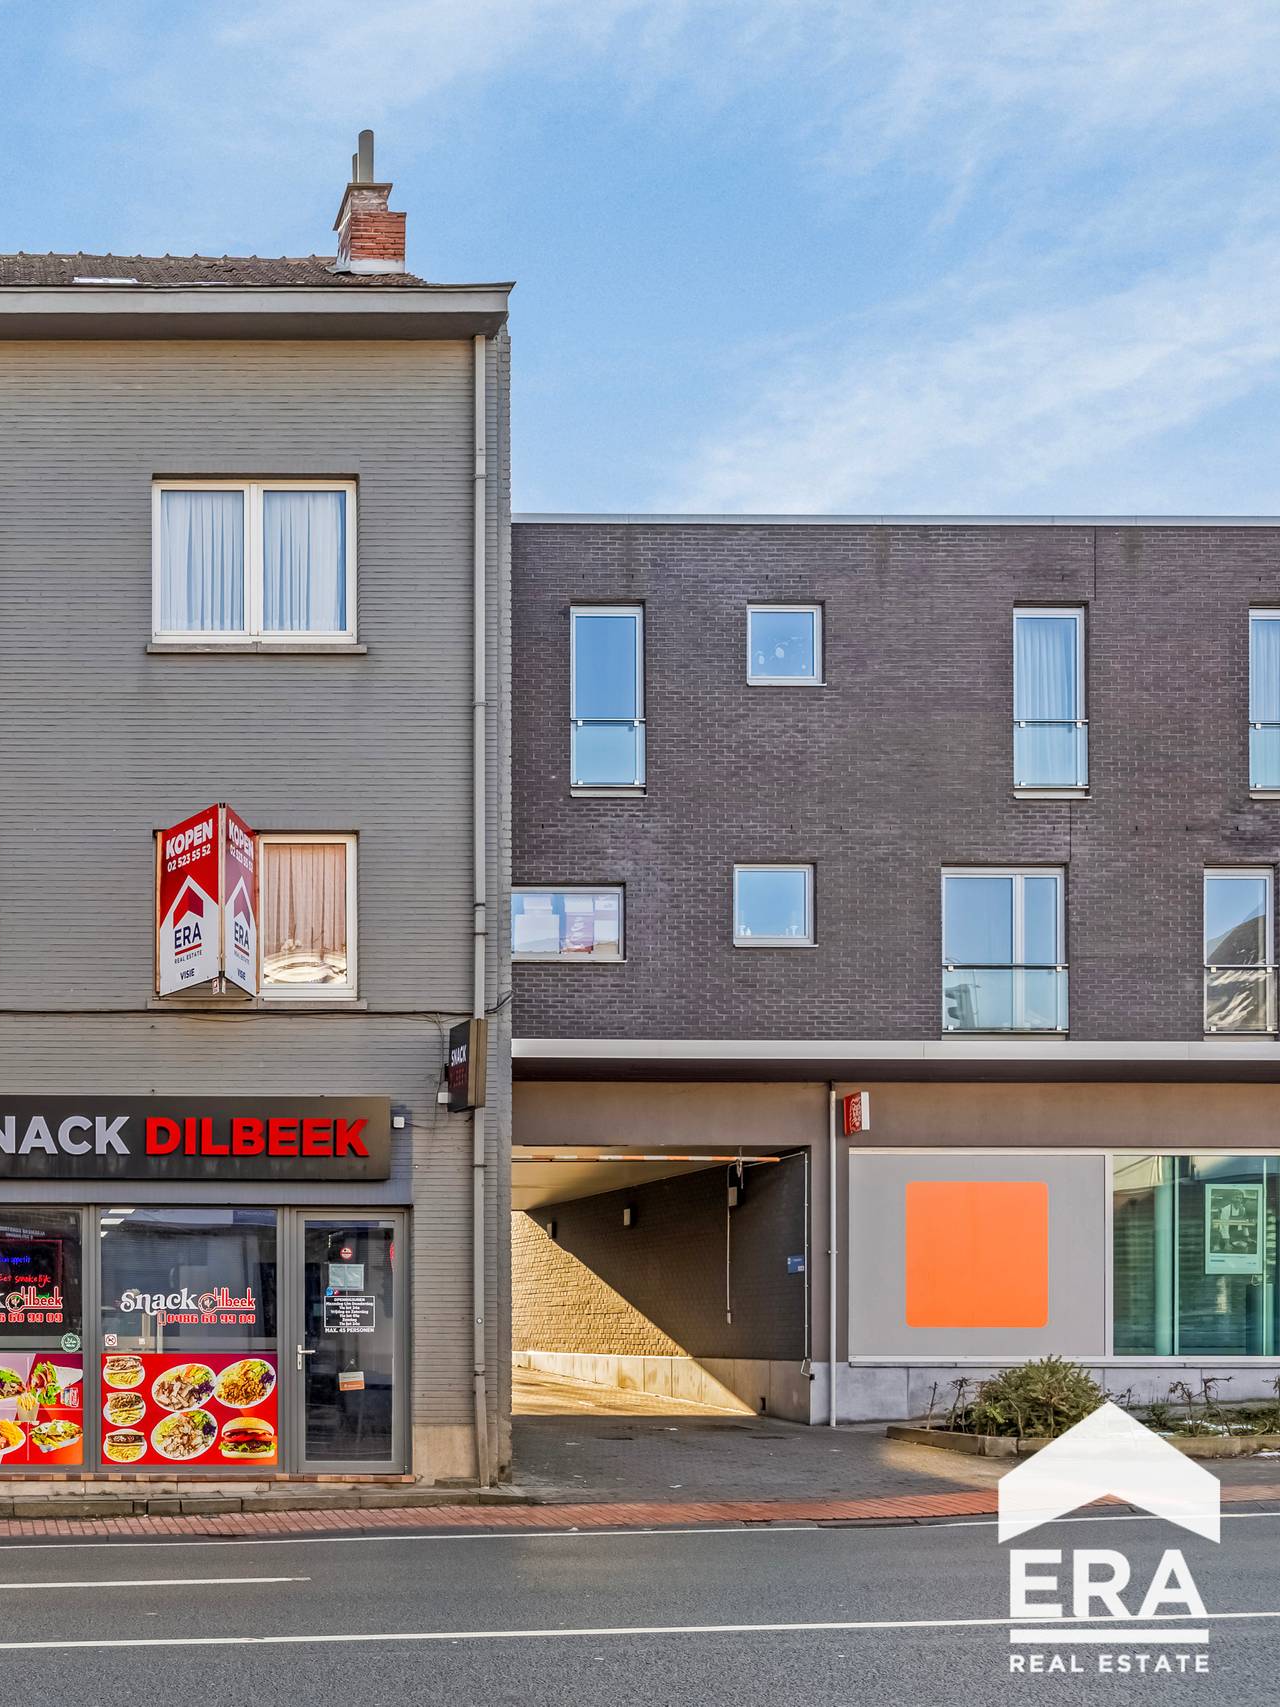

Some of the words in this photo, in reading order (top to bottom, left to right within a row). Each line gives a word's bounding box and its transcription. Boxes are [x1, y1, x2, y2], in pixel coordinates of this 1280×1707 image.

[166, 818, 213, 860] KOPEN
[228, 819, 254, 860] KOPEN
[167, 860, 177, 872] 02
[177, 852, 190, 868] 523
[191, 848, 201, 862] 55
[202, 843, 211, 857] 52
[175, 922, 202, 949] ERA
[234, 921, 250, 949] ERA
[174, 956, 185, 964] REAL
[186, 949, 202, 961] ESTATE
[180, 968, 195, 980] VISIE
[451, 1044, 467, 1067] SNACK
[145, 1117, 370, 1157] DILBEEK
